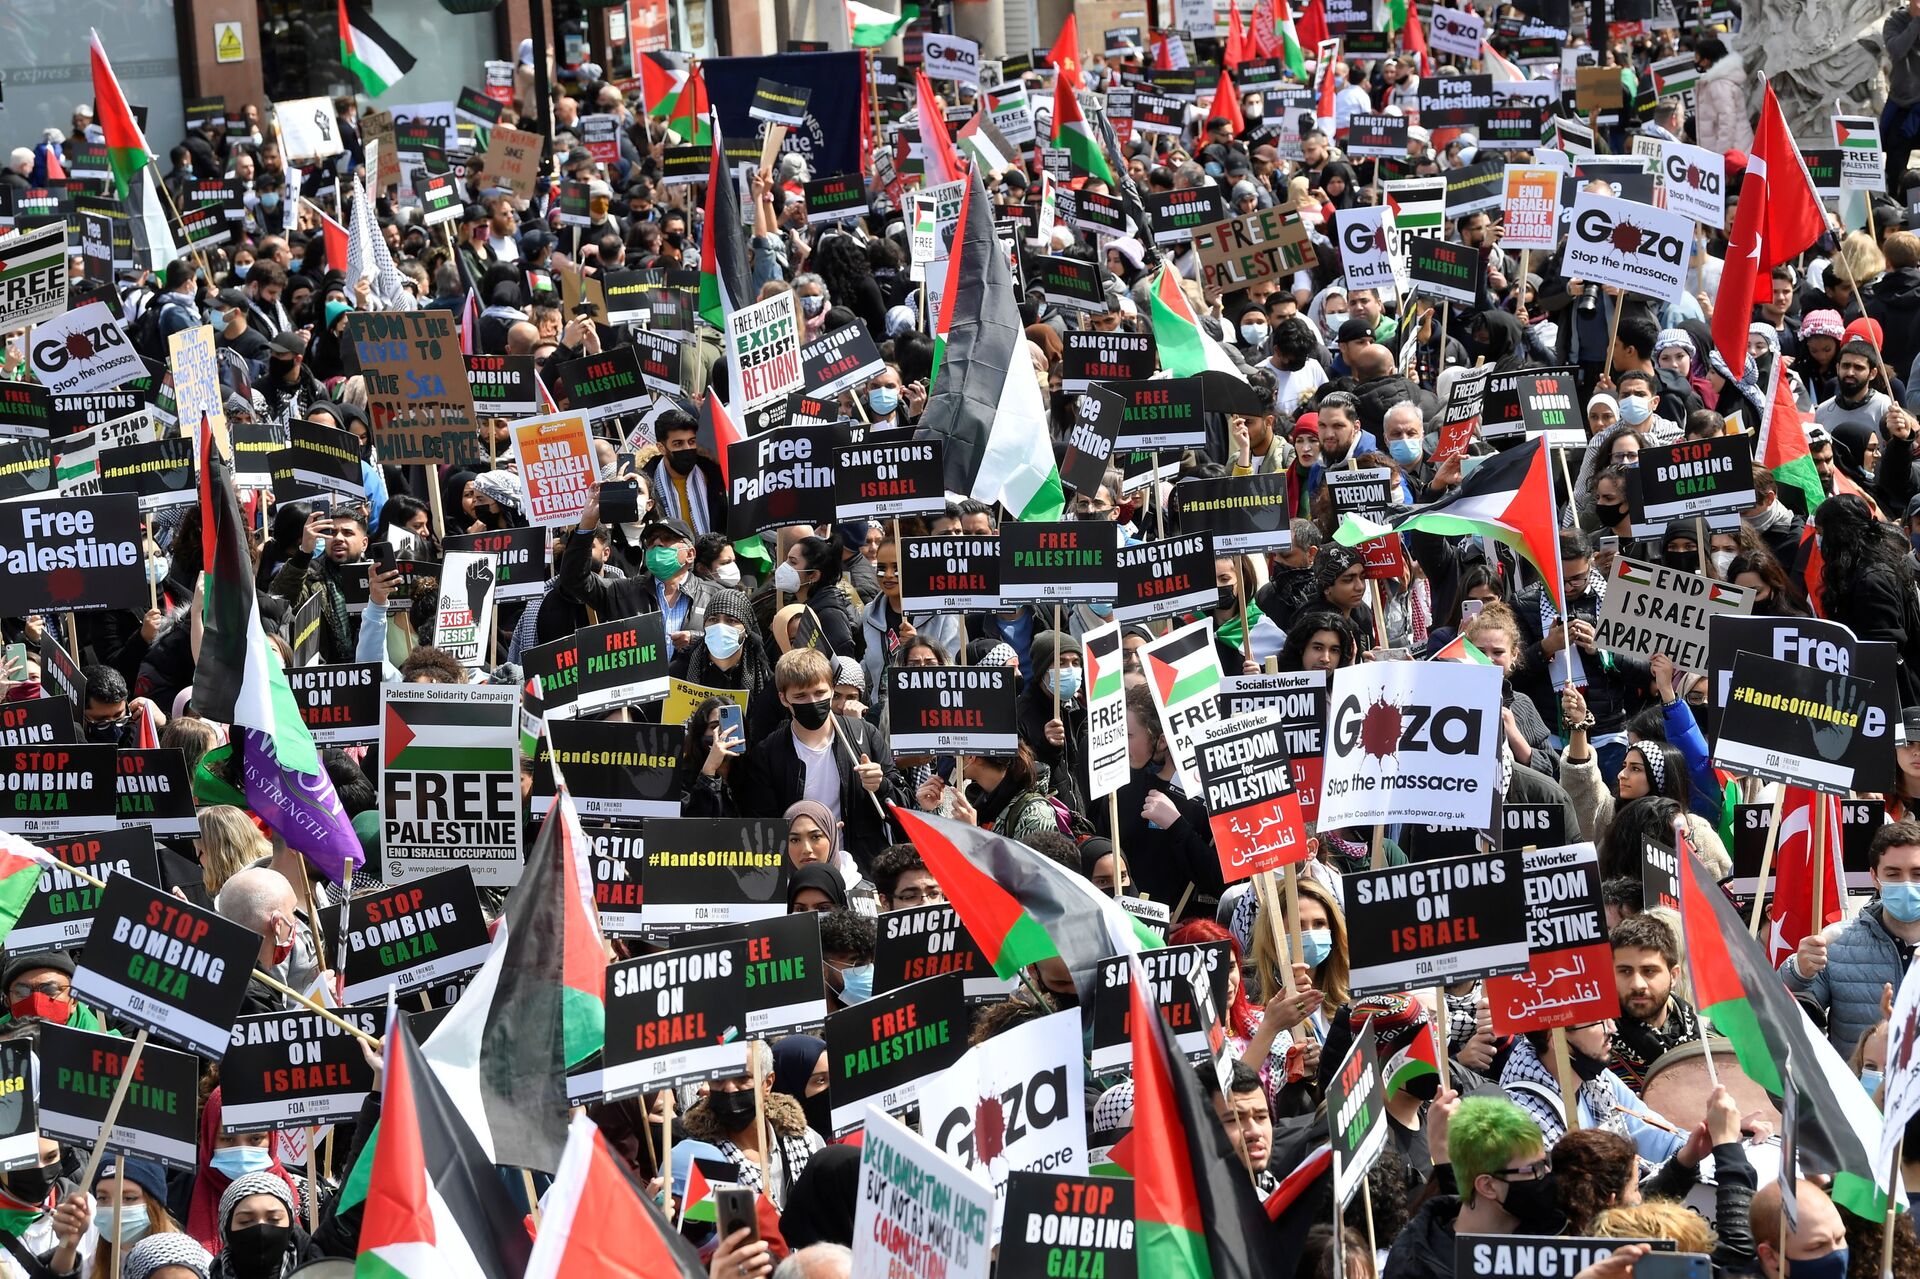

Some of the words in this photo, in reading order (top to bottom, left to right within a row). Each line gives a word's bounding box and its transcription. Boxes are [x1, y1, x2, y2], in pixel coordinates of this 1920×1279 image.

[1434, 13, 1477, 40] Gza
[926, 42, 975, 66] Gza
[13, 66, 72, 81] express
[1438, 79, 1472, 94] Free
[1422, 92, 1490, 111] Palestine
[802, 111, 824, 147] WEST
[1353, 114, 1404, 128] SANCTIONS
[1371, 125, 1385, 136] ON
[1487, 118, 1532, 130] BOMBING
[1840, 151, 1879, 162] FREE
[823, 181, 846, 193] FREE
[1666, 155, 1720, 196] Gza
[811, 188, 860, 205] PALESTINE
[1170, 191, 1196, 203] STOP
[1519, 185, 1543, 200] END
[1669, 189, 1685, 202] Stop
[1082, 200, 1119, 219] BOMBING
[1161, 200, 1211, 217] BOMBING
[1506, 198, 1553, 212] ISRAELI
[1510, 211, 1547, 224] STATE
[914, 237, 933, 248] FREE
[1216, 212, 1279, 252] FREE
[1504, 223, 1552, 239] TERROR
[1576, 209, 1684, 266] Gza
[1204, 239, 1316, 285] PALESTINE
[1434, 248, 1456, 262] FREE
[1350, 264, 1373, 277] End
[1378, 261, 1392, 274] th
[1419, 257, 1468, 279] PALESTINE
[1571, 250, 1598, 265] Stop
[1602, 256, 1620, 269] the
[1623, 263, 1678, 286] massacre
[734, 312, 752, 335] FREE
[753, 297, 790, 328] PALESTINE
[352, 315, 406, 342] FROM
[406, 317, 449, 338] THE
[737, 317, 794, 353] EXIST!
[32, 319, 127, 373] Gza
[1070, 335, 1148, 352] SANCTIONS
[652, 350, 662, 363] ON
[824, 350, 843, 365] ON
[1100, 350, 1118, 363] ON
[587, 361, 615, 380] FREE
[742, 355, 799, 402] RETURN!
[818, 355, 860, 383] ISRAEL
[1085, 362, 1132, 378] ISRAEL
[473, 386, 505, 398] GAZA
[575, 371, 635, 397] PALESTINE
[1135, 389, 1169, 405] FREE
[1529, 394, 1571, 410] BOMBING
[101, 416, 149, 441] STAND
[1542, 411, 1565, 425] GAZA
[538, 440, 571, 460] END
[758, 437, 812, 470] Free
[841, 445, 933, 467] SANCTIONS
[1672, 444, 1712, 463] STOP
[104, 458, 190, 479] #HandsOffAlAqsa
[527, 453, 591, 480] ISRAELI
[877, 465, 898, 480] ON
[1657, 457, 1733, 482] BOMBING
[538, 472, 585, 495] STATE
[861, 479, 916, 497] ISRAEL
[1335, 485, 1385, 503] FREEDOM
[1676, 479, 1716, 495] GAZA
[1182, 494, 1283, 513] #HandsOffAlAqsa
[21, 508, 94, 538] Free
[910, 541, 1000, 559] SANCTIONS
[1039, 533, 1077, 549] FREE
[1117, 537, 1204, 568] SANCTIONS
[946, 558, 967, 574] ON
[1014, 550, 1102, 567] PALESTINE
[1151, 560, 1173, 578] ON
[929, 575, 986, 591] ISRAEL
[1137, 574, 1190, 598] ISRAEL
[1656, 570, 1704, 596] END
[440, 612, 472, 628] EXIST.
[1622, 591, 1705, 630] ISRAEL
[439, 627, 475, 644] RESIST.
[605, 630, 637, 652] FREE
[587, 644, 657, 675] PALESTINE
[898, 672, 1003, 690] SANCTIONS
[308, 688, 332, 706] ON
[386, 689, 424, 700] Palestine
[426, 690, 468, 702] Solidarity
[471, 691, 514, 704] Campaign
[940, 690, 963, 708] ON
[1734, 687, 1858, 728] #HandsOffAlAqsa
[921, 709, 984, 727] ISRAEL
[1091, 700, 1124, 733] FREE
[1333, 694, 1483, 758] Gza
[1092, 725, 1125, 750] PALESTINE
[15, 753, 69, 770] STOP
[1204, 731, 1279, 772] FREEDOM
[1241, 763, 1254, 776] for
[1209, 767, 1290, 811] PALESTINE
[1327, 778, 1349, 797] Stop
[1352, 773, 1376, 791] the
[1381, 774, 1478, 793] massacre
[15, 793, 69, 811] GAZA
[385, 773, 516, 821] FREE
[1231, 806, 1283, 836] الحرية
[385, 822, 516, 844] PALESTINE
[388, 847, 408, 858] END
[410, 847, 451, 859] ISRAELI
[453, 847, 516, 860] OCCUPATION
[1232, 828, 1296, 868] لفلسطين
[597, 861, 626, 881] ON
[649, 852, 782, 868] #HandsOffAlAqsa
[1357, 859, 1506, 904] SANCTIONS
[365, 889, 424, 923] STOP
[1416, 894, 1450, 922] ON
[147, 900, 209, 945] STOP
[349, 902, 457, 952] BOMBING
[928, 930, 955, 954] ON
[1392, 917, 1479, 953] ISRAEL
[112, 916, 226, 986] BOMBING
[379, 934, 439, 967] GAZA
[127, 954, 190, 1001] GAZA
[614, 950, 733, 998] SANCTIONS
[904, 951, 974, 981] ISRAEL
[656, 987, 684, 1018] ON
[1508, 981, 1601, 1020] لفلسطين
[636, 1012, 707, 1051] ISRAEL
[871, 1003, 917, 1041] FREE
[289, 1041, 322, 1065] ON
[845, 1020, 950, 1079] PALESTINE
[264, 1063, 351, 1094] ISRAEL
[1341, 1049, 1364, 1098] STOP
[935, 1065, 1069, 1172] Gza
[1348, 1104, 1369, 1151] GAZA
[864, 1131, 950, 1219] DECOLONISATION
[1054, 1183, 1114, 1215] STOP
[1026, 1213, 1134, 1250] BOMBING
[1048, 1250, 1105, 1279] GAZA
